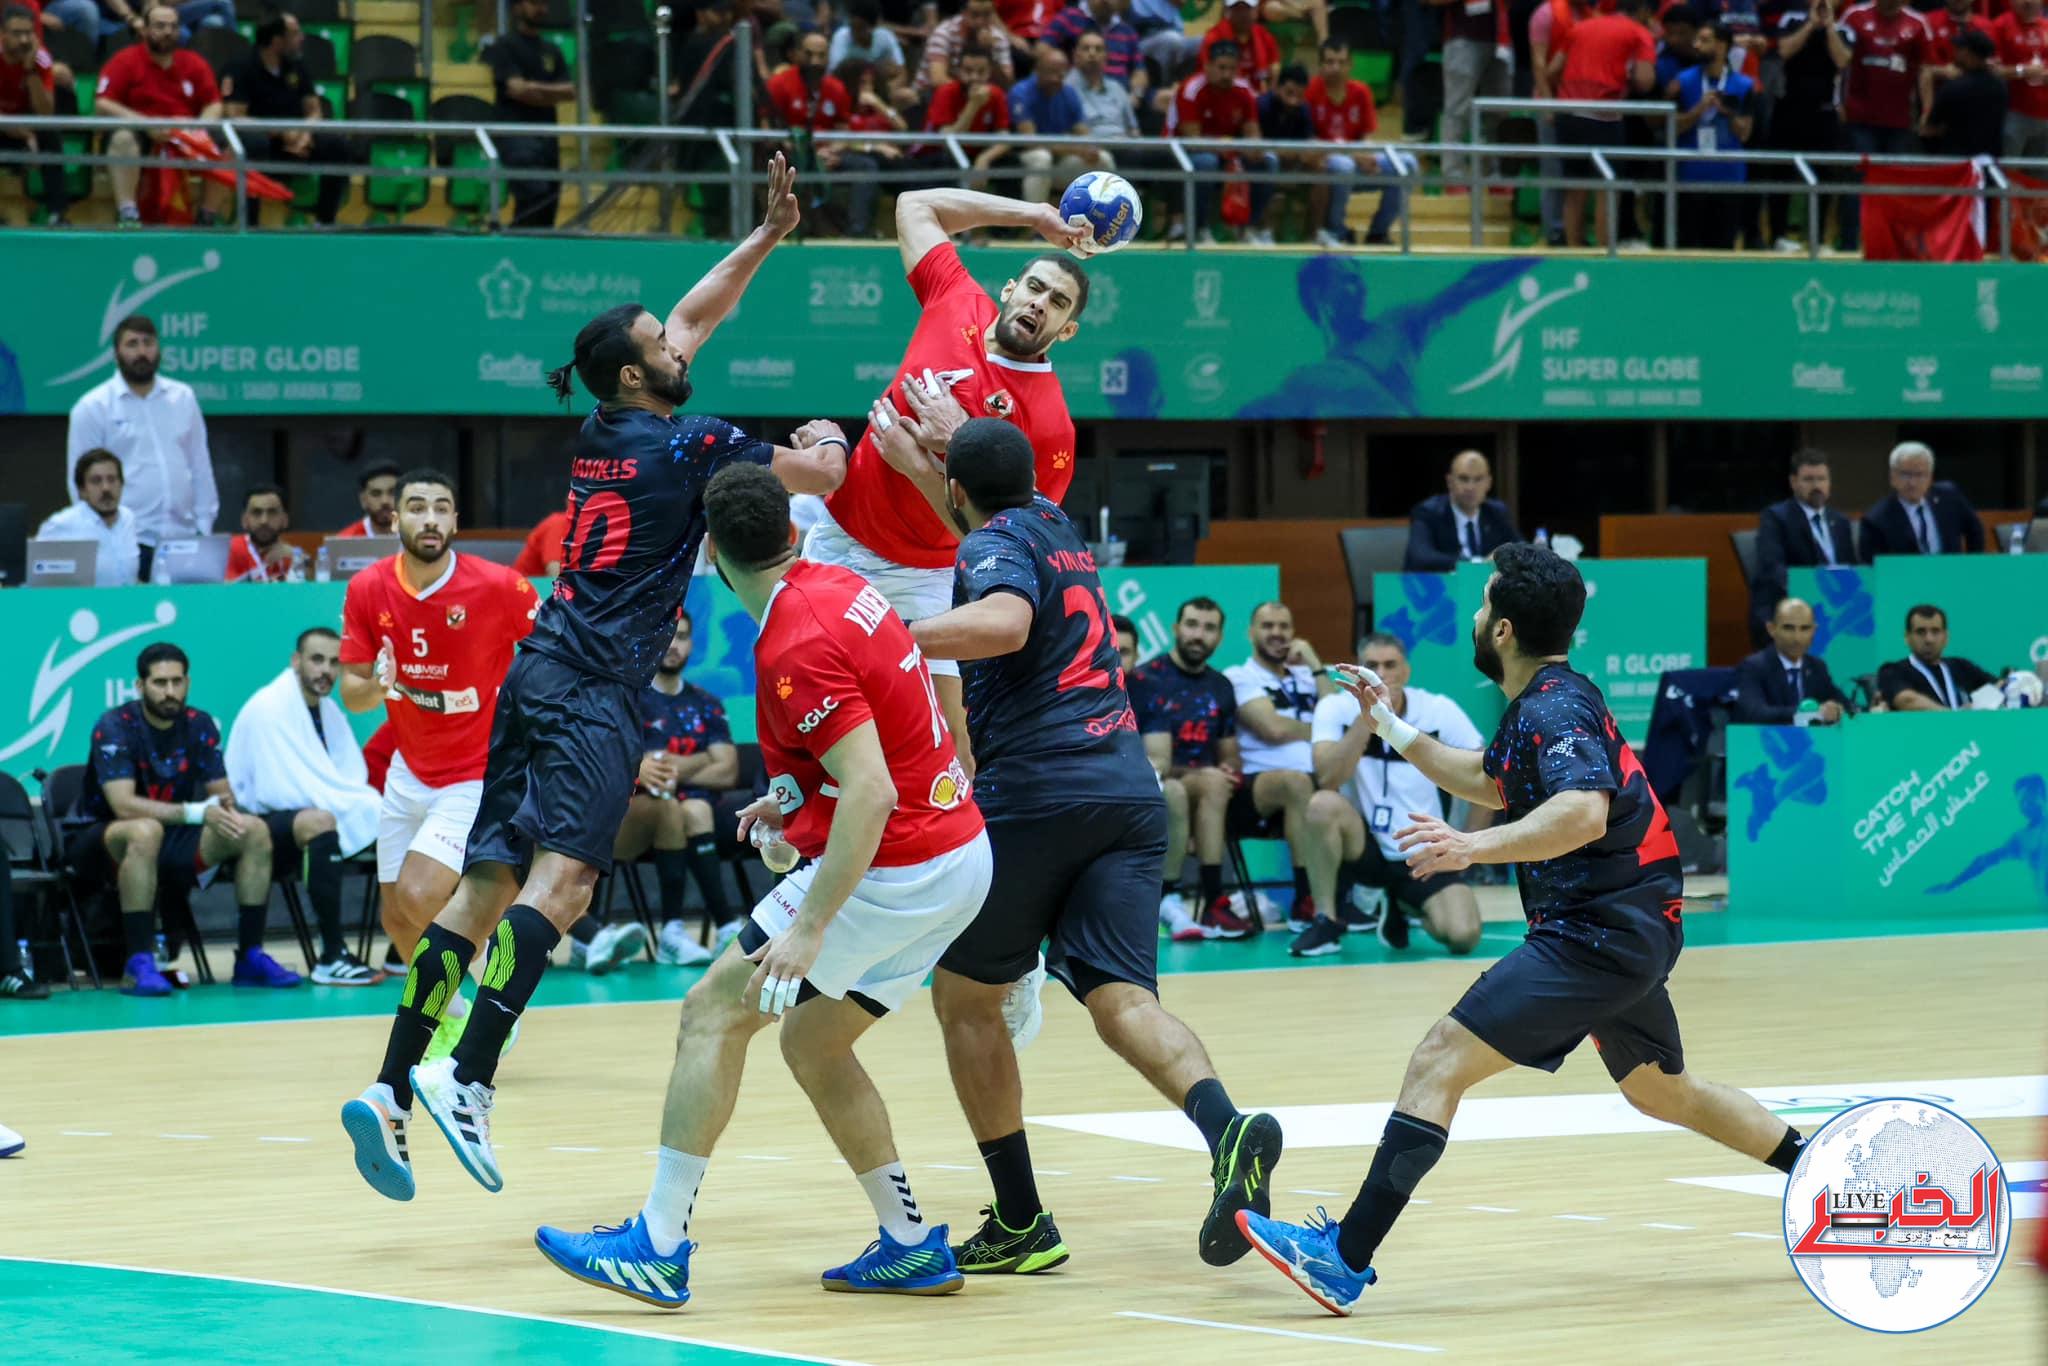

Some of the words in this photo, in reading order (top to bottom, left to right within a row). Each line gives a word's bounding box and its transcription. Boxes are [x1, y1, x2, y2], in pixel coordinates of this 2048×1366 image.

[161, 312, 208, 338] IHF
[1542, 327, 1580, 350] IHF
[161, 346, 257, 372] SUPER
[265, 346, 361, 372] GLOBE
[1543, 356, 1618, 381] SUPER
[1624, 356, 1699, 381] GLOBE
[411, 628, 429, 657] 5
[1854, 770, 1920, 839] CATCH
[1862, 811, 1906, 855] THE
[1911, 740, 1980, 817] ACTION
